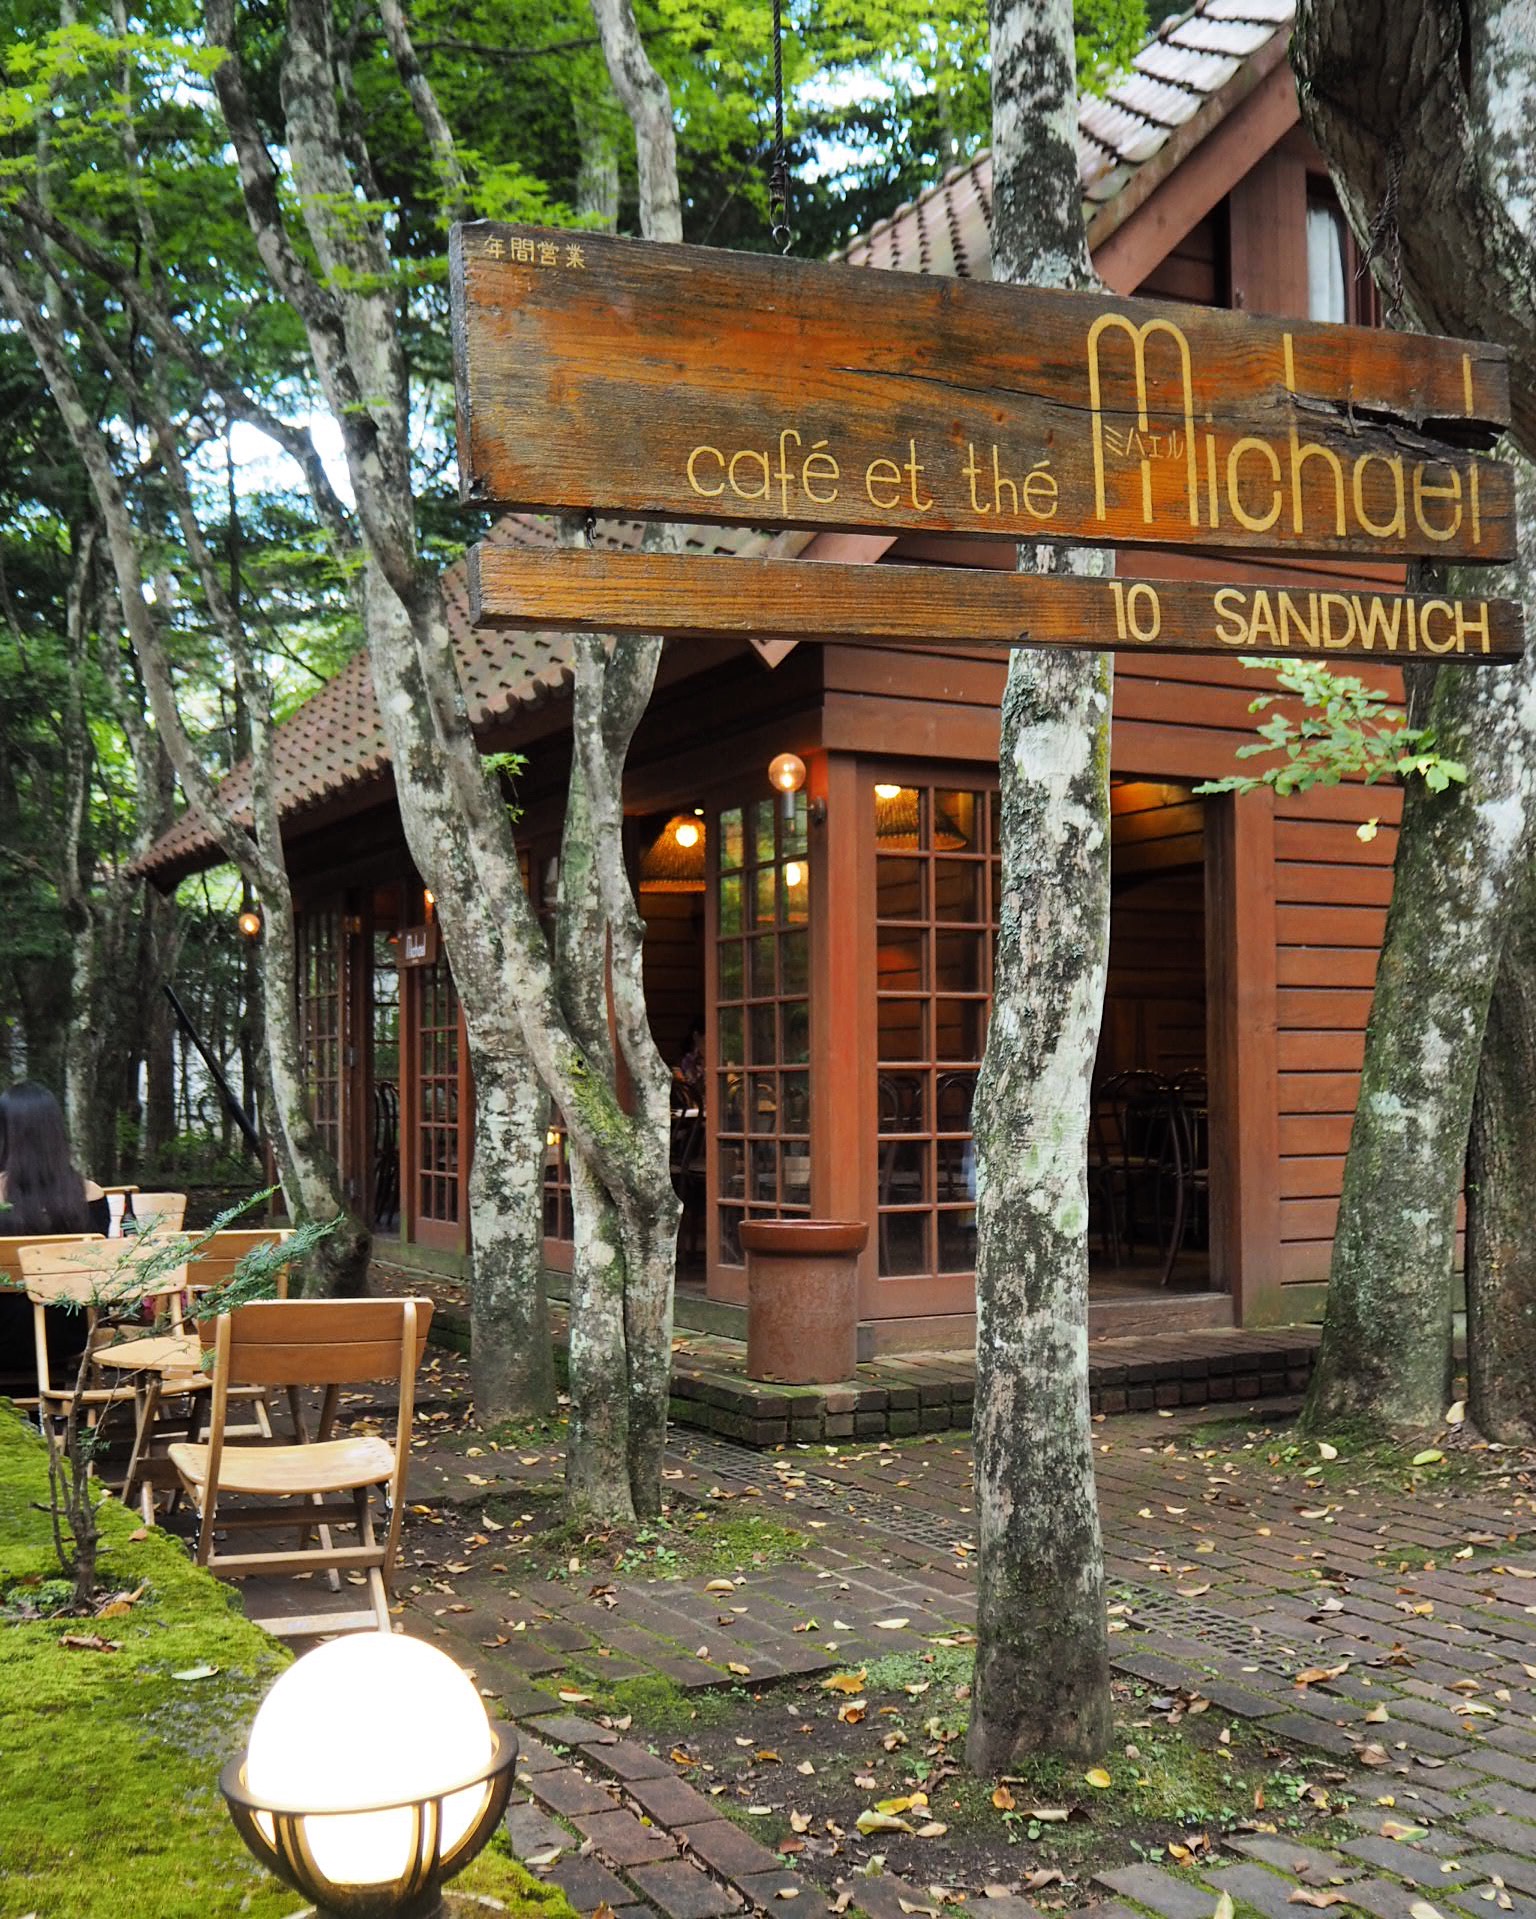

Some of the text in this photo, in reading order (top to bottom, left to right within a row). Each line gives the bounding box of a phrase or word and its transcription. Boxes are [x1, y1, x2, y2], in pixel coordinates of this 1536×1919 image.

[484, 234, 586, 269] 年間営業
[687, 313, 1482, 545] café et thé Michael
[1103, 424, 1185, 460] ミハエル
[1109, 581, 1491, 654] 10 SANDWICH
